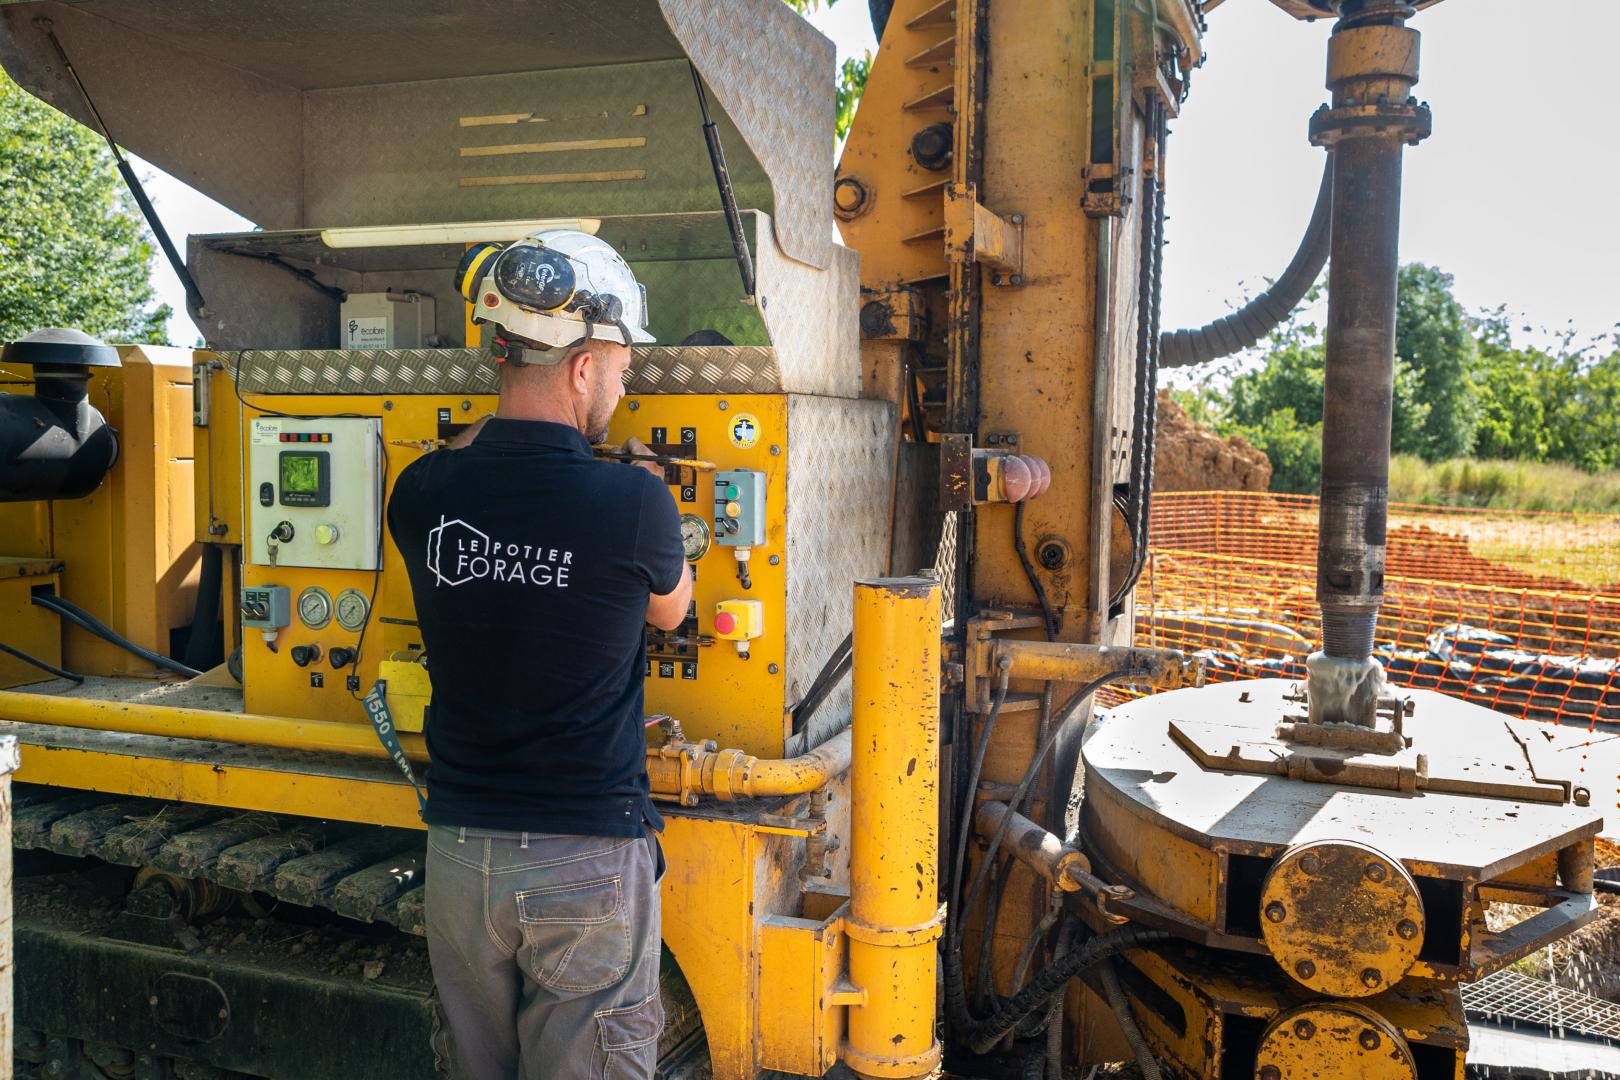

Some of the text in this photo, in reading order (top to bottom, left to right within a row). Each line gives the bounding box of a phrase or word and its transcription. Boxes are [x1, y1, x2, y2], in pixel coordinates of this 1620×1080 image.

[458, 538, 573, 565] LE POTIER
[457, 554, 569, 588] FORAGE
